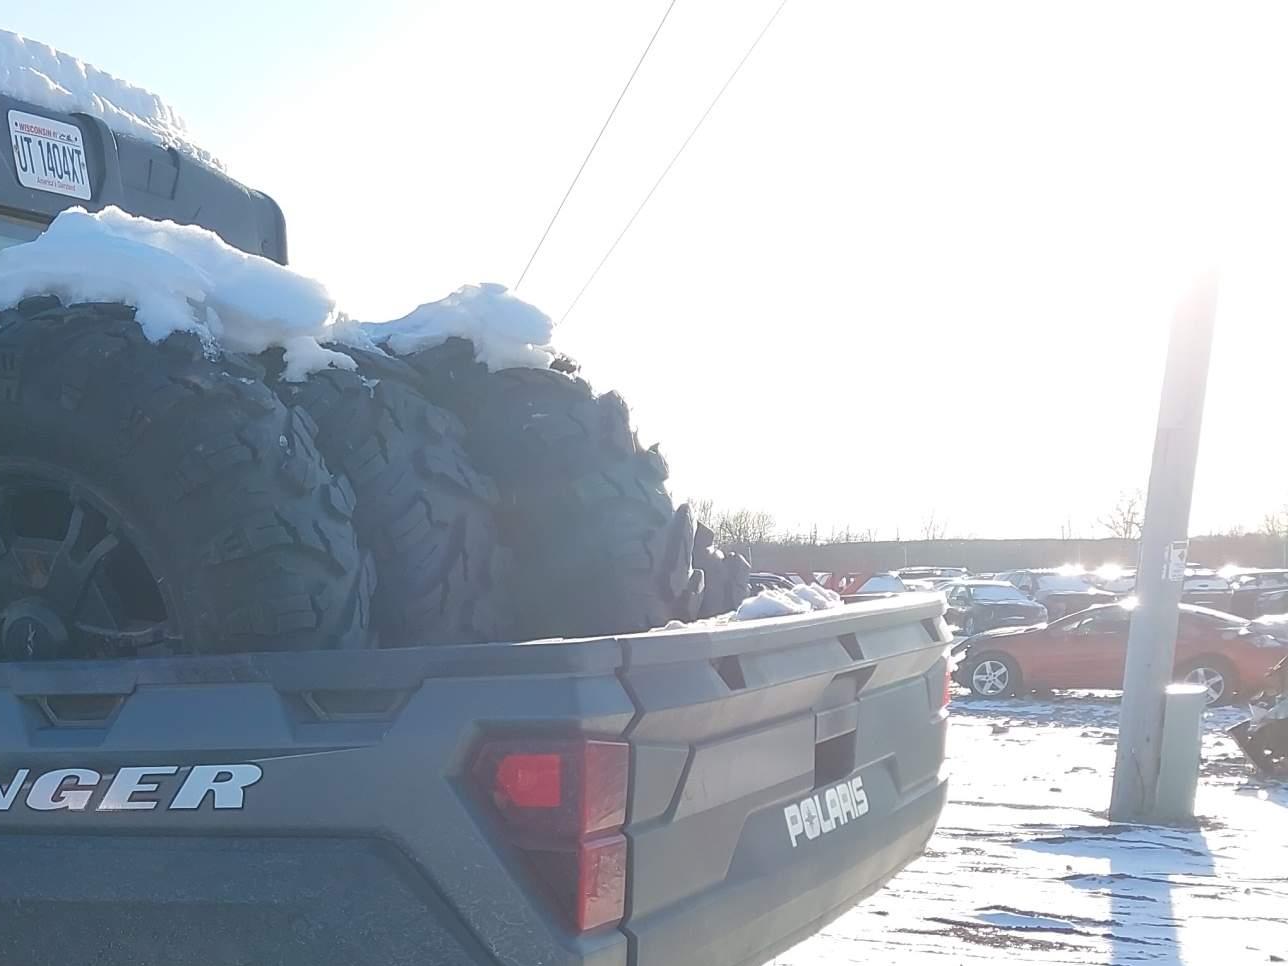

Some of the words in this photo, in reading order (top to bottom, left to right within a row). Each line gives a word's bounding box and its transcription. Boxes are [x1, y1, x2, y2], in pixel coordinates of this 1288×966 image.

[18, 122, 53, 137] WISCONSIN
[14, 135, 35, 174] UT
[38, 140, 84, 185] 1404XT
[783, 775, 869, 848] POLARIS
